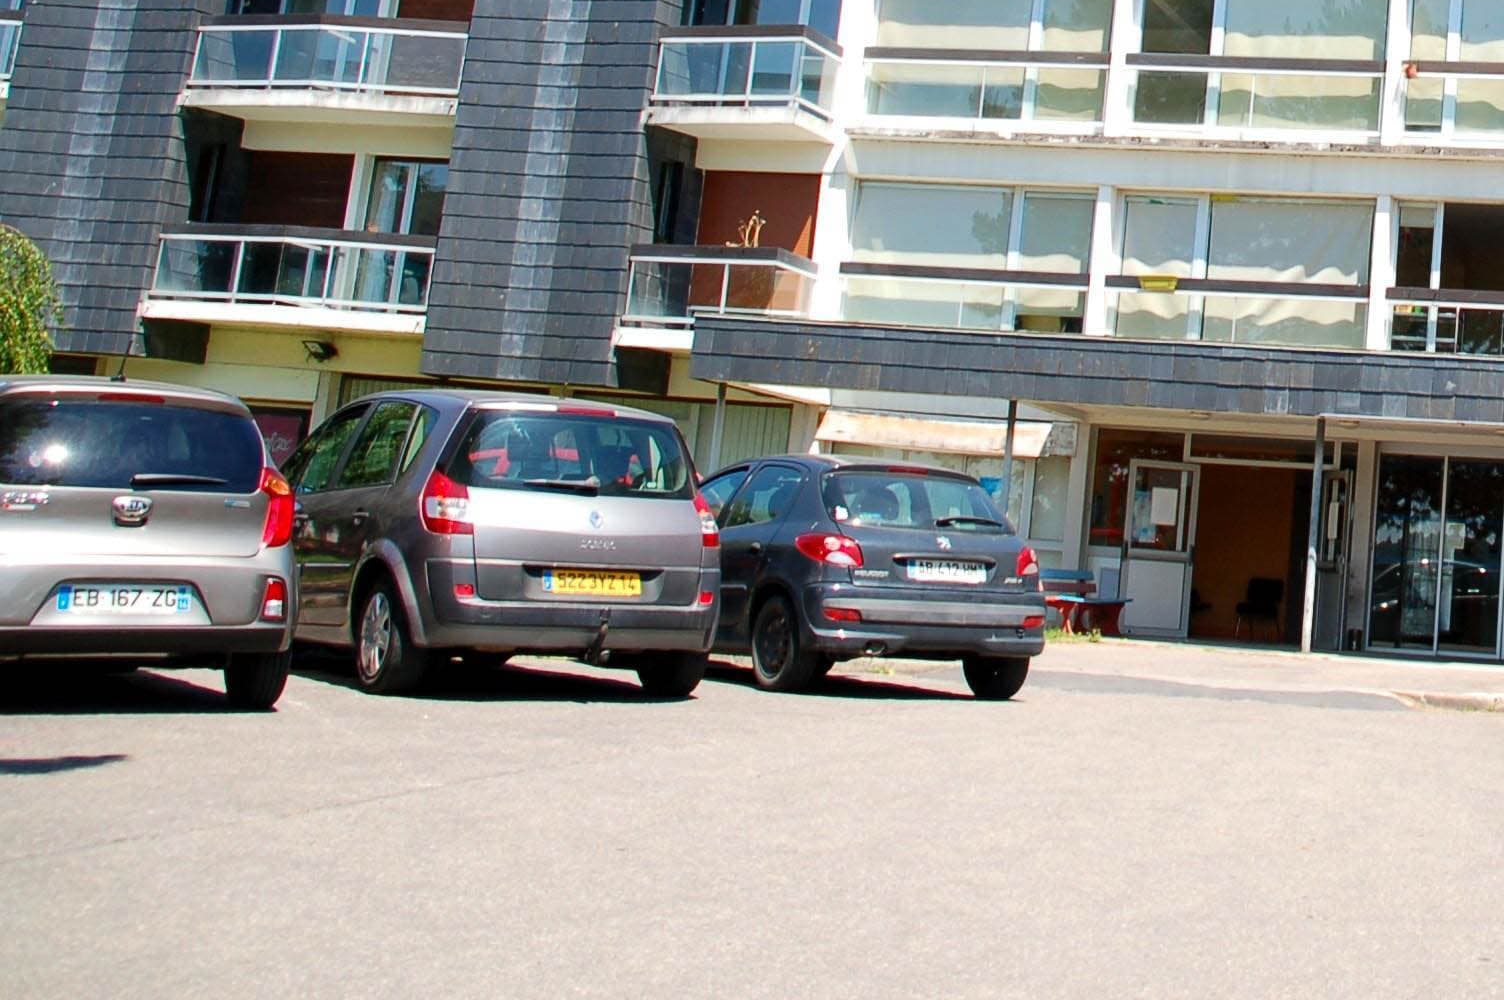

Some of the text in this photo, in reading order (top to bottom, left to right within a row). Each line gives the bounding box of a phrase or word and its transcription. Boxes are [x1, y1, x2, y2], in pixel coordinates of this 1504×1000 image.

[73, 588, 177, 608] EB 167 ZG
